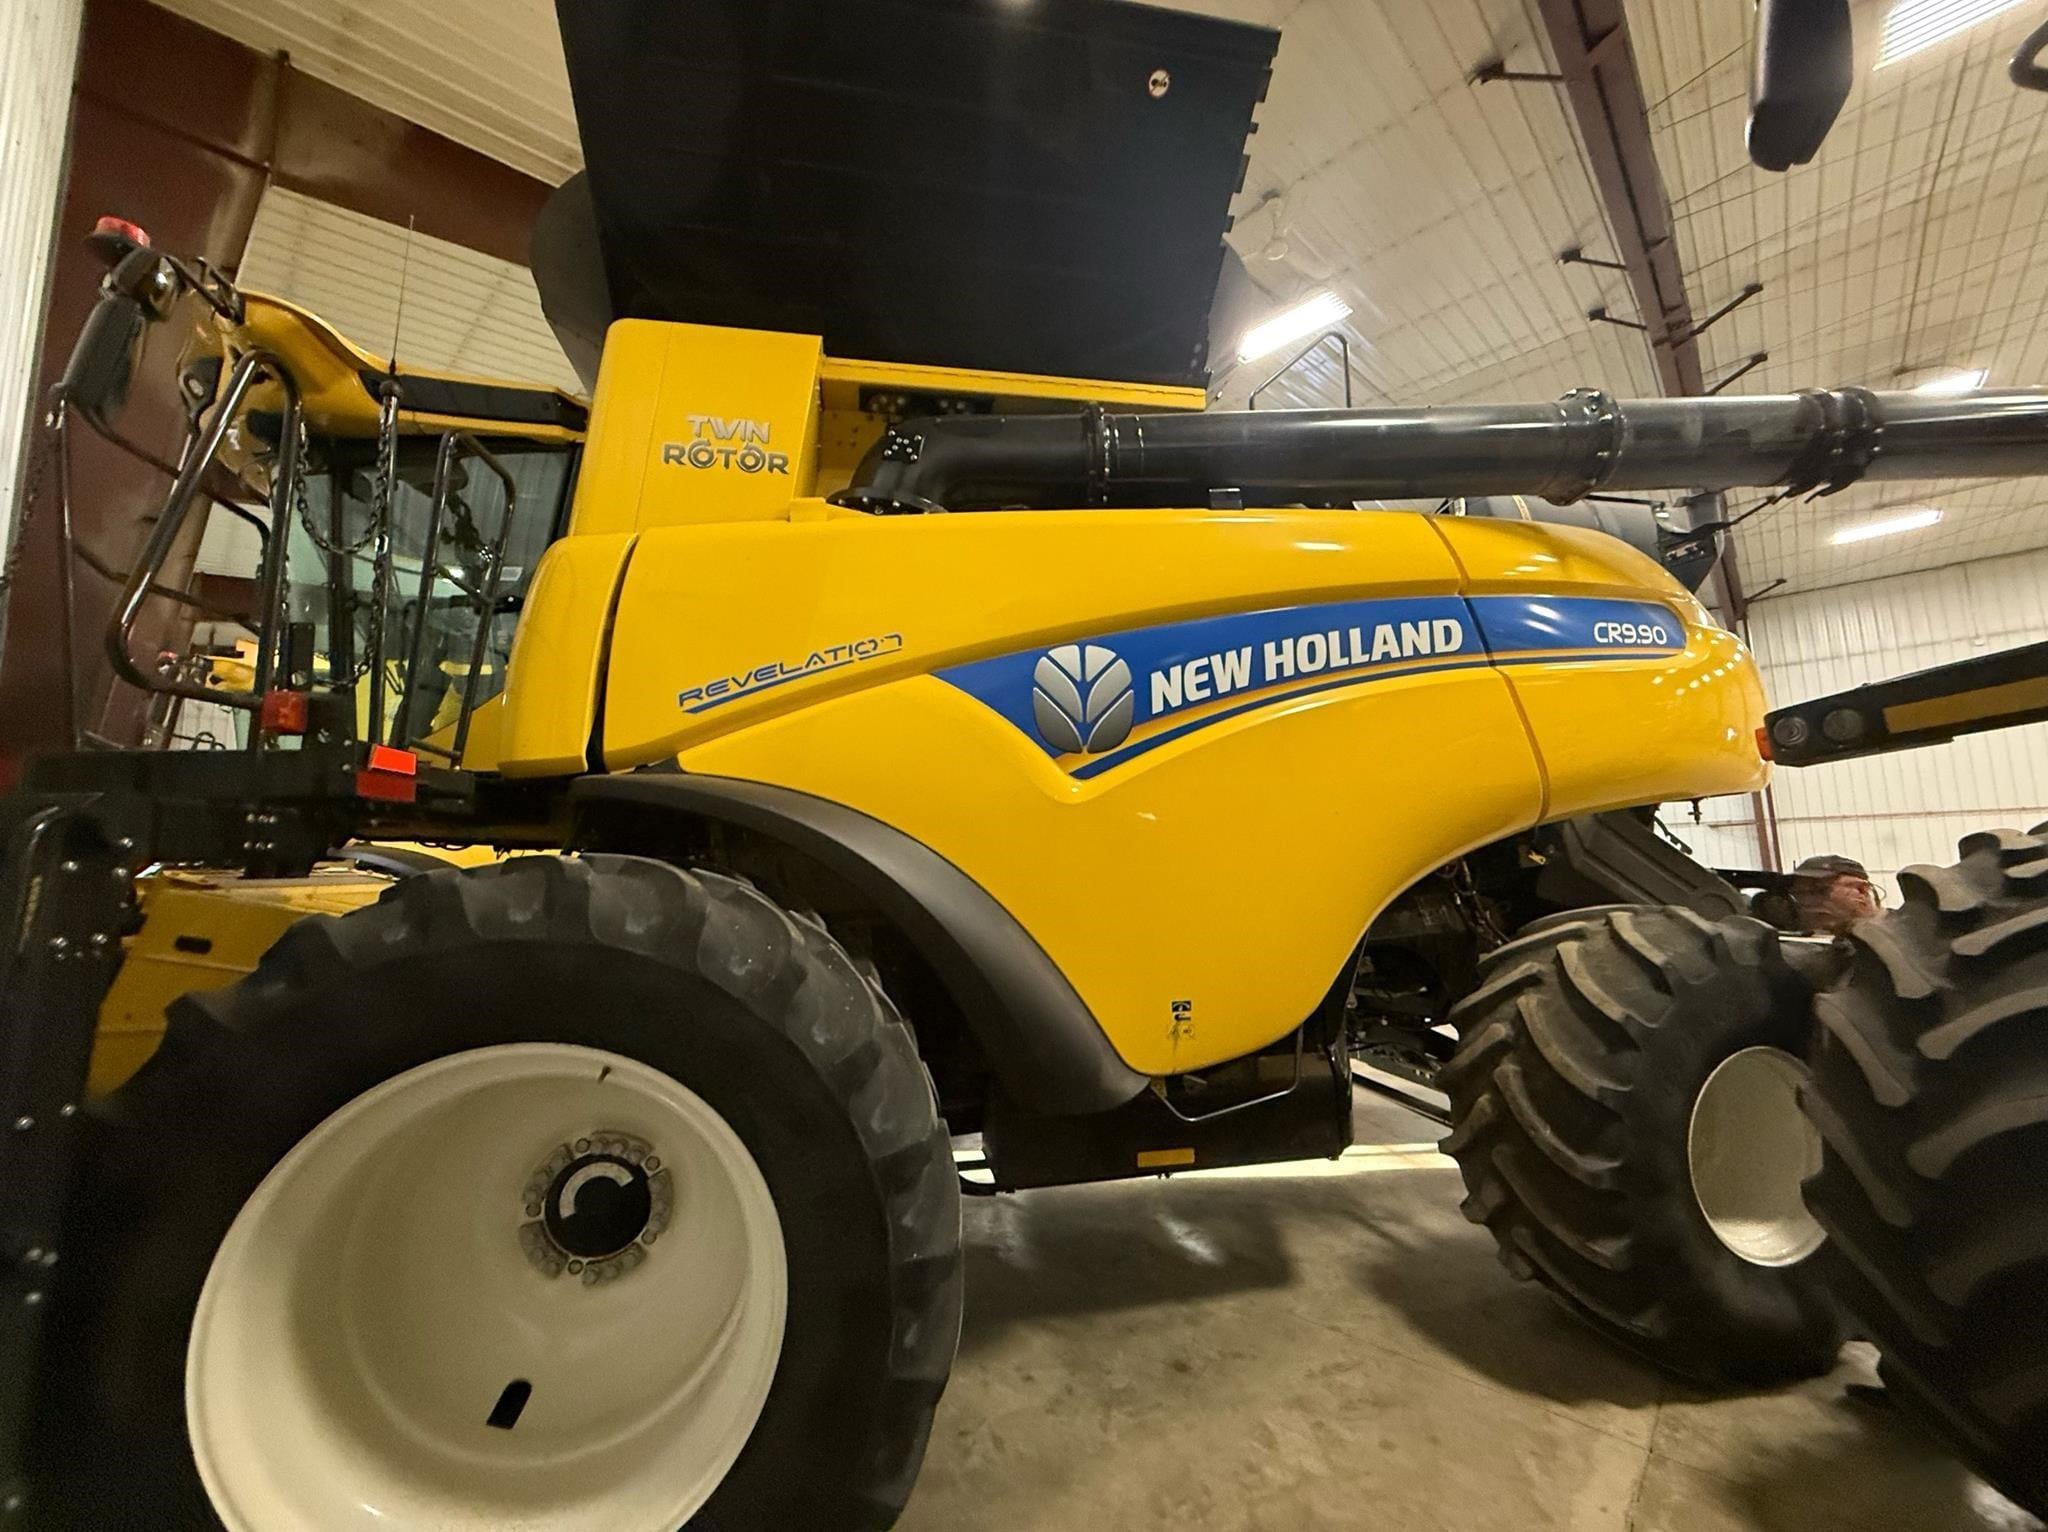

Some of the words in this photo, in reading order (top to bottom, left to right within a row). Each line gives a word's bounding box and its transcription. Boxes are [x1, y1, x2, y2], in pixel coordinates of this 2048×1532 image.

[687, 414, 769, 444] TWIN
[663, 440, 790, 474] ROTOR
[1593, 622, 1668, 645] CR9.90
[1151, 646, 1252, 714] NEW
[1263, 618, 1463, 682] HOLLAND
